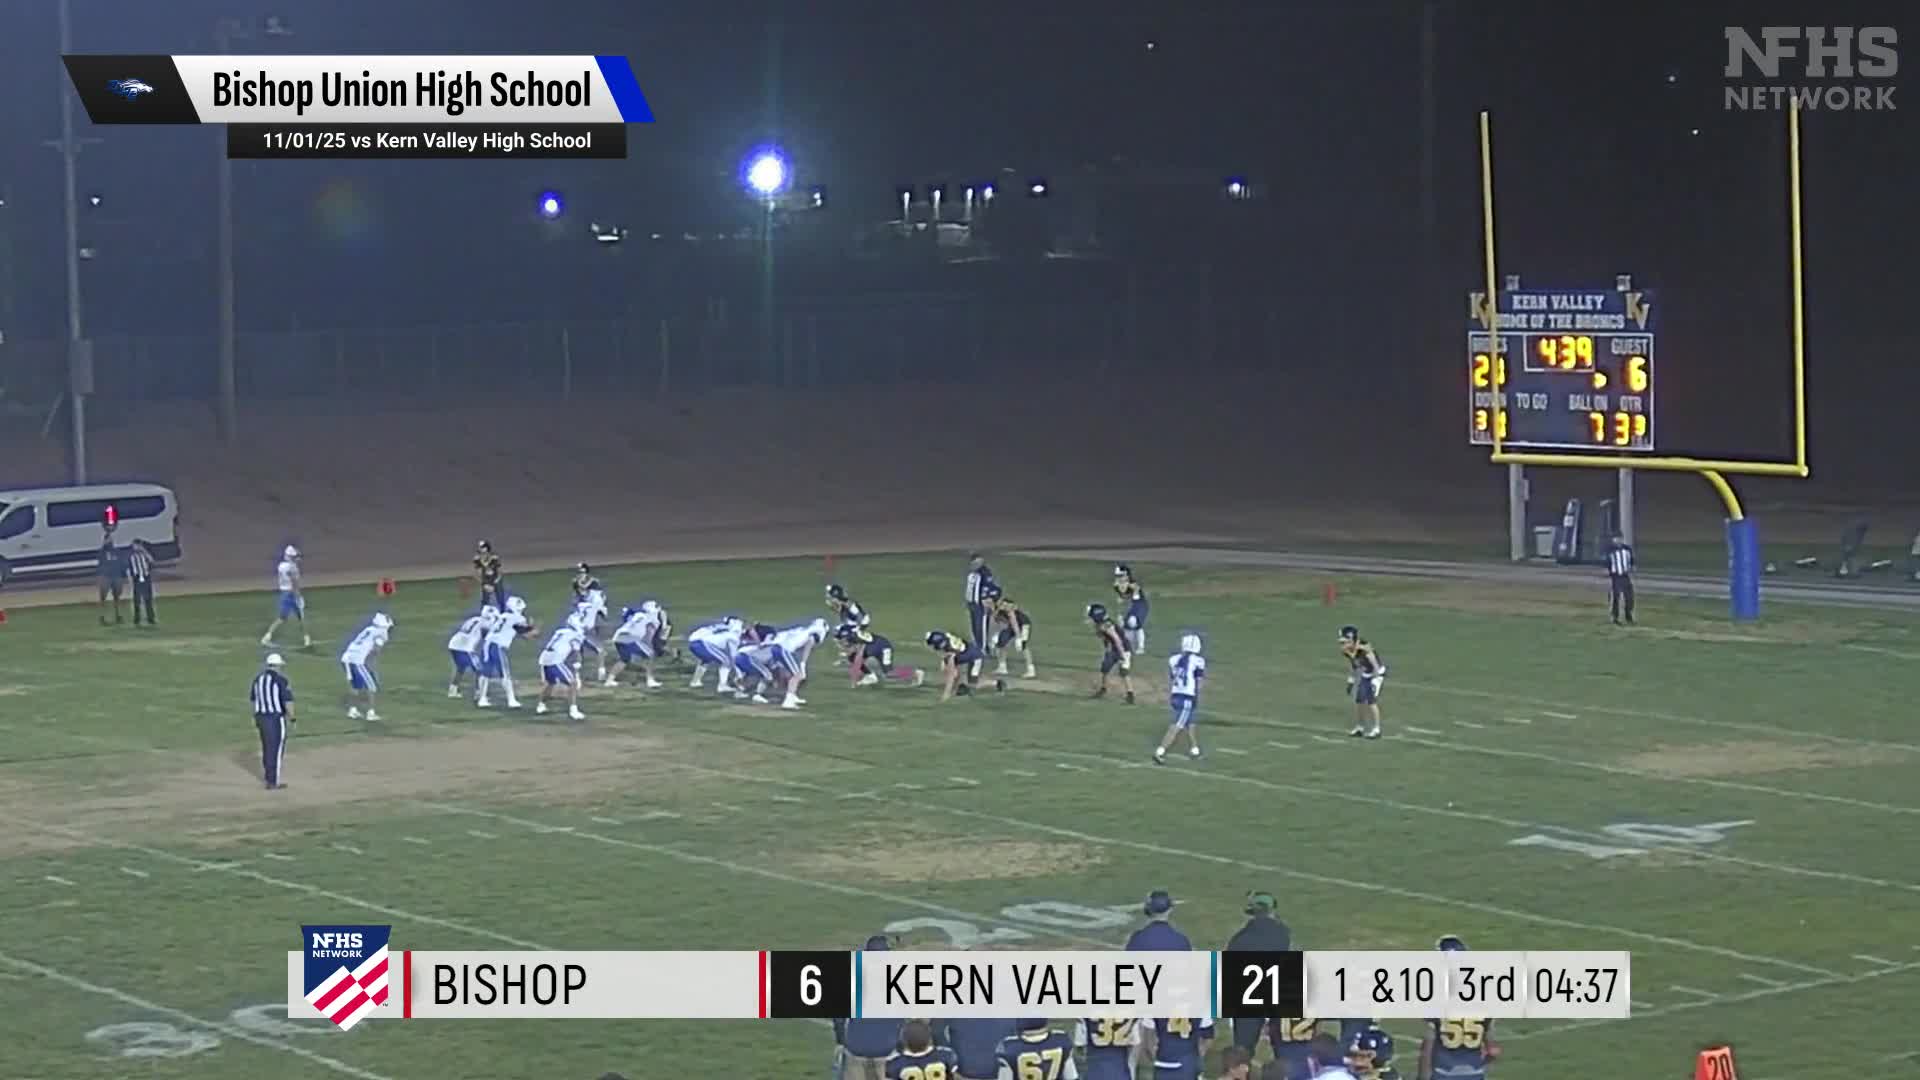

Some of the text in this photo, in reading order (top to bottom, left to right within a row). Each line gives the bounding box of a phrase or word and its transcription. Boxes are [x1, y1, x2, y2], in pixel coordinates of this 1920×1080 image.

[1512, 295, 1605, 311] KERN VALLEY
[1548, 314, 1573, 329] THE
[1611, 338, 1648, 354] GUEST
[1629, 356, 1647, 392] 6
[1516, 392, 1548, 410] TO GO
[1439, 1018, 1484, 1048] 55
[1017, 1048, 1063, 1080] 67
